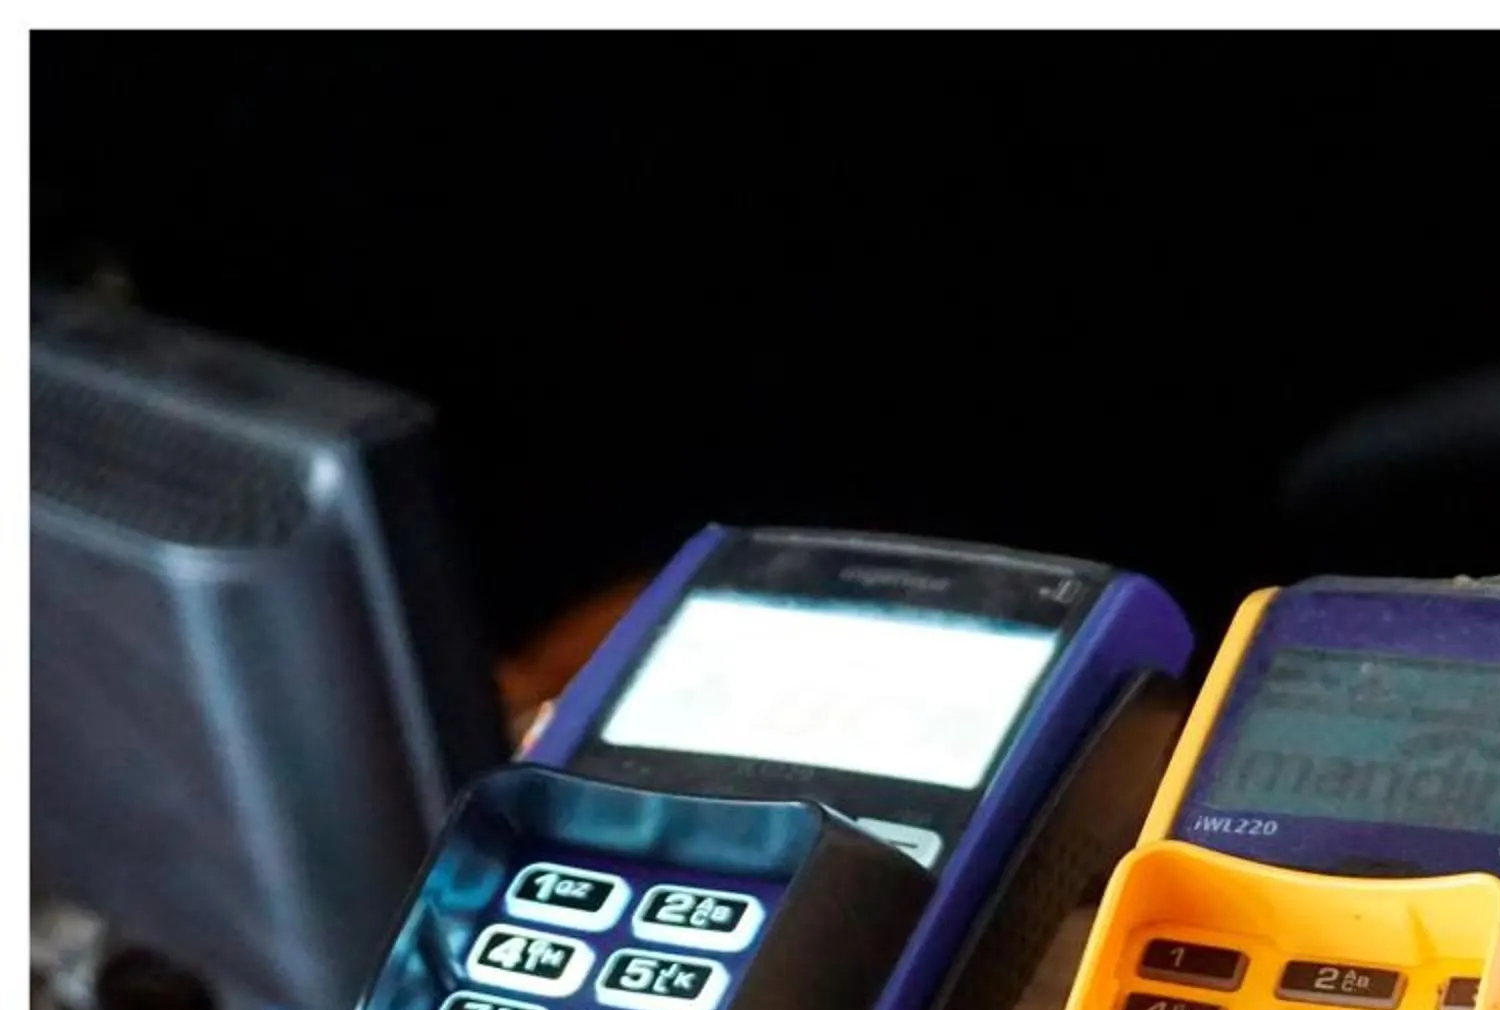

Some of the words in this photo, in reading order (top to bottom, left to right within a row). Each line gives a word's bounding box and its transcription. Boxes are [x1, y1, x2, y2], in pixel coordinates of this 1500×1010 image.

[1194, 815, 1279, 836] iWL220
[534, 873, 558, 901] 1
[656, 893, 696, 923] 2
[487, 936, 527, 969] 4
[1169, 946, 1186, 968] 1
[620, 957, 658, 990] 5
[1314, 967, 1340, 990] 2
